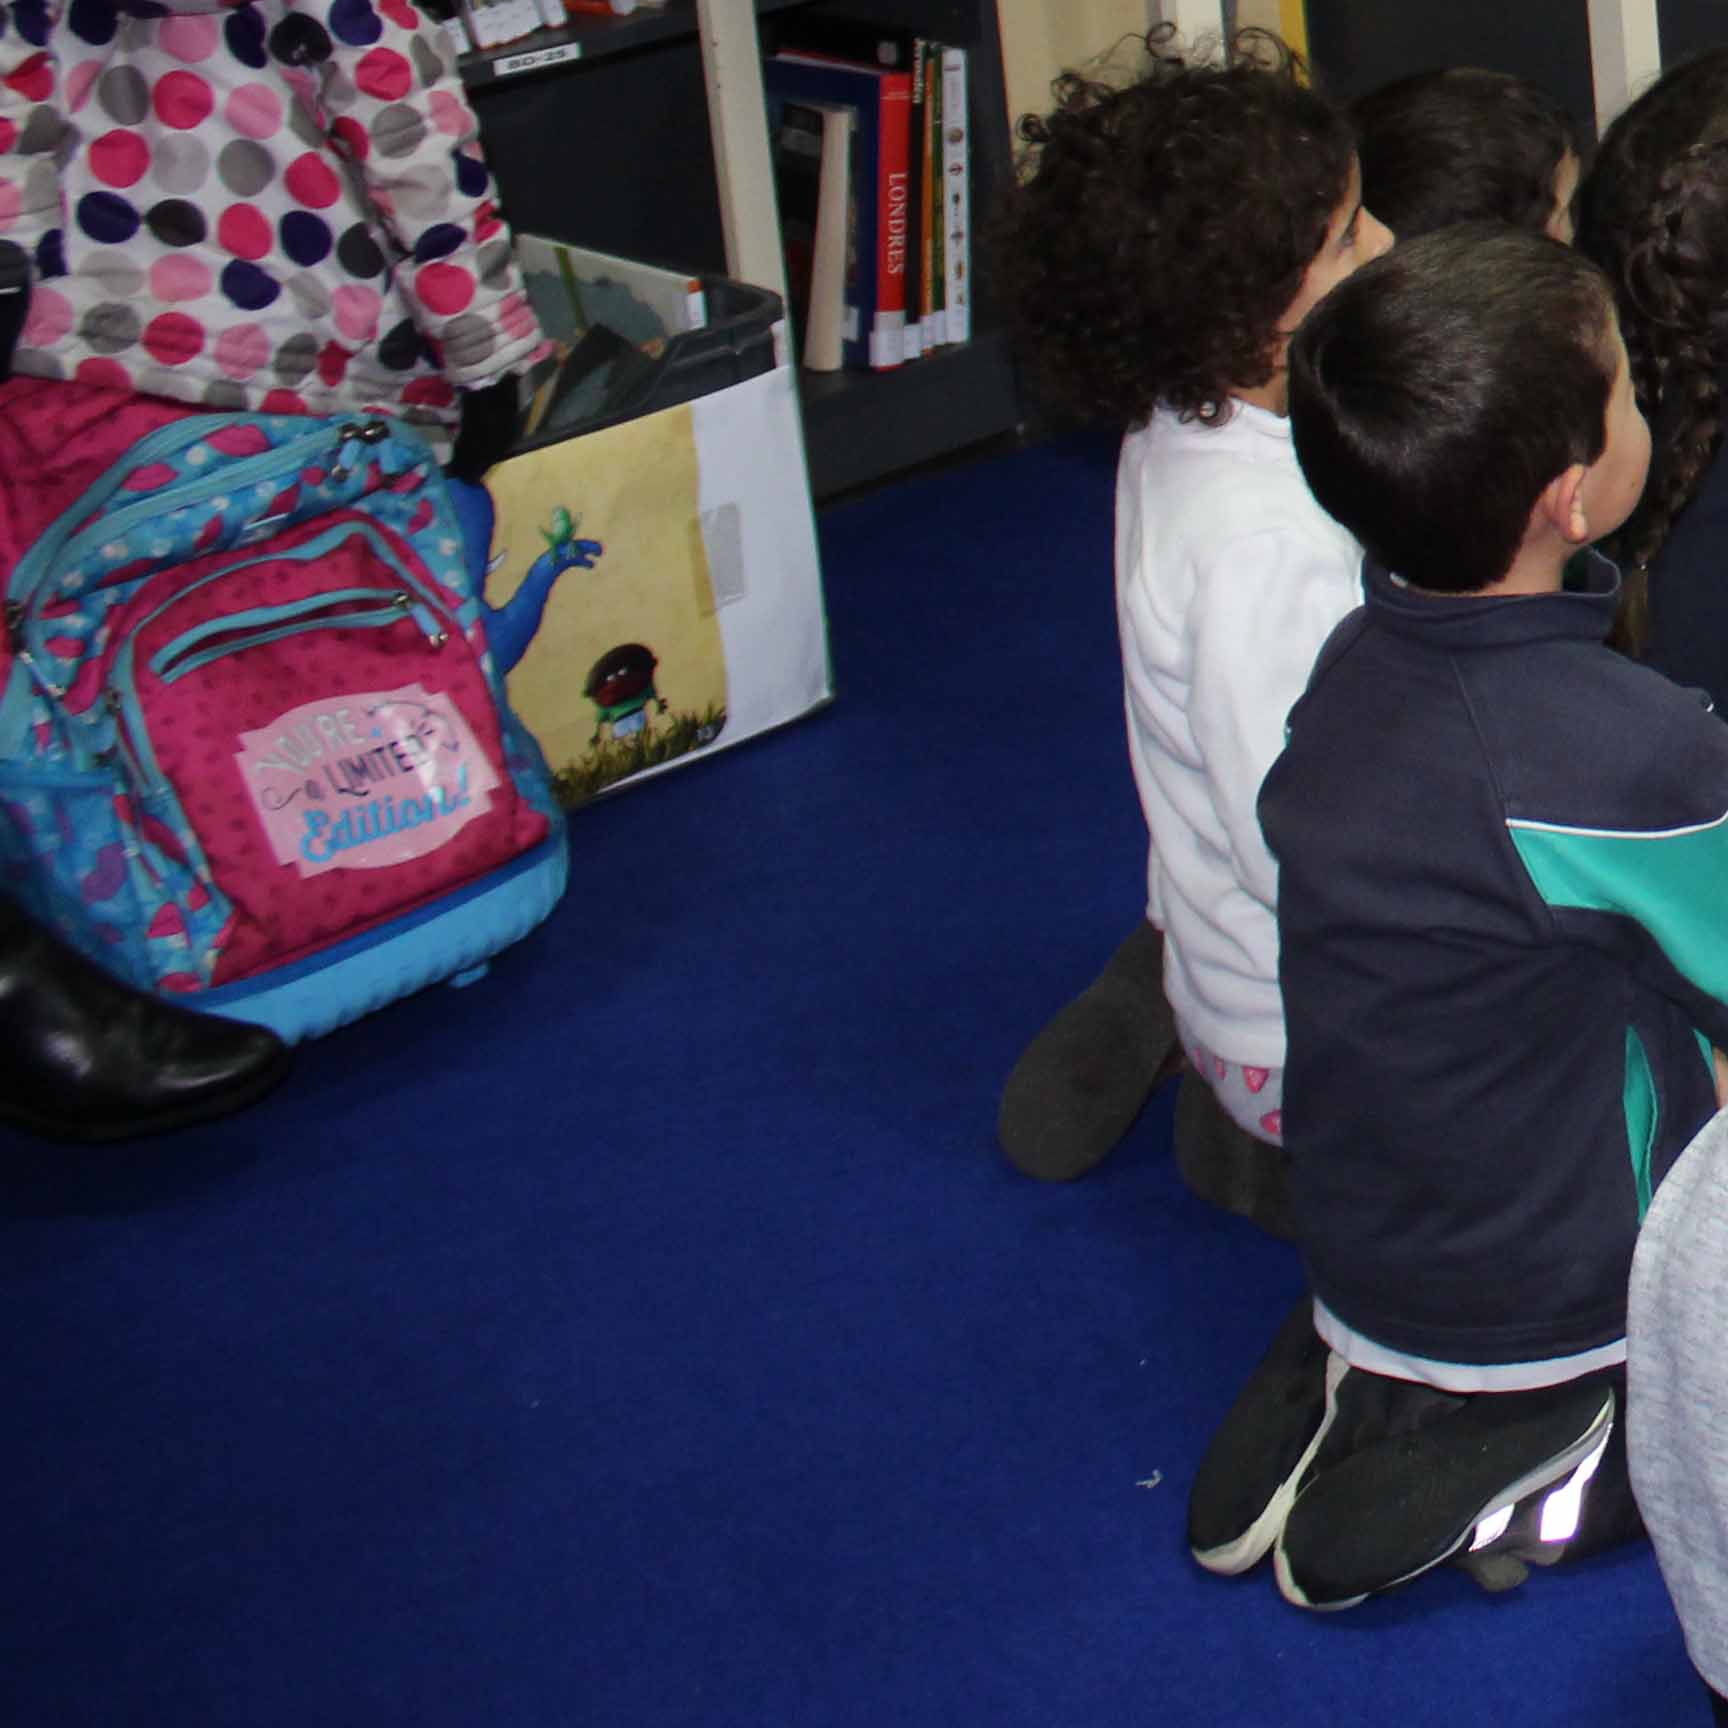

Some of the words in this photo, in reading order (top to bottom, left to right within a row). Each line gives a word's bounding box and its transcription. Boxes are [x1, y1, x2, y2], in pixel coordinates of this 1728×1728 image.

[886, 171, 908, 276] LONDRES
[255, 709, 367, 775] YOU'RE
[301, 762, 472, 864] Edition!
